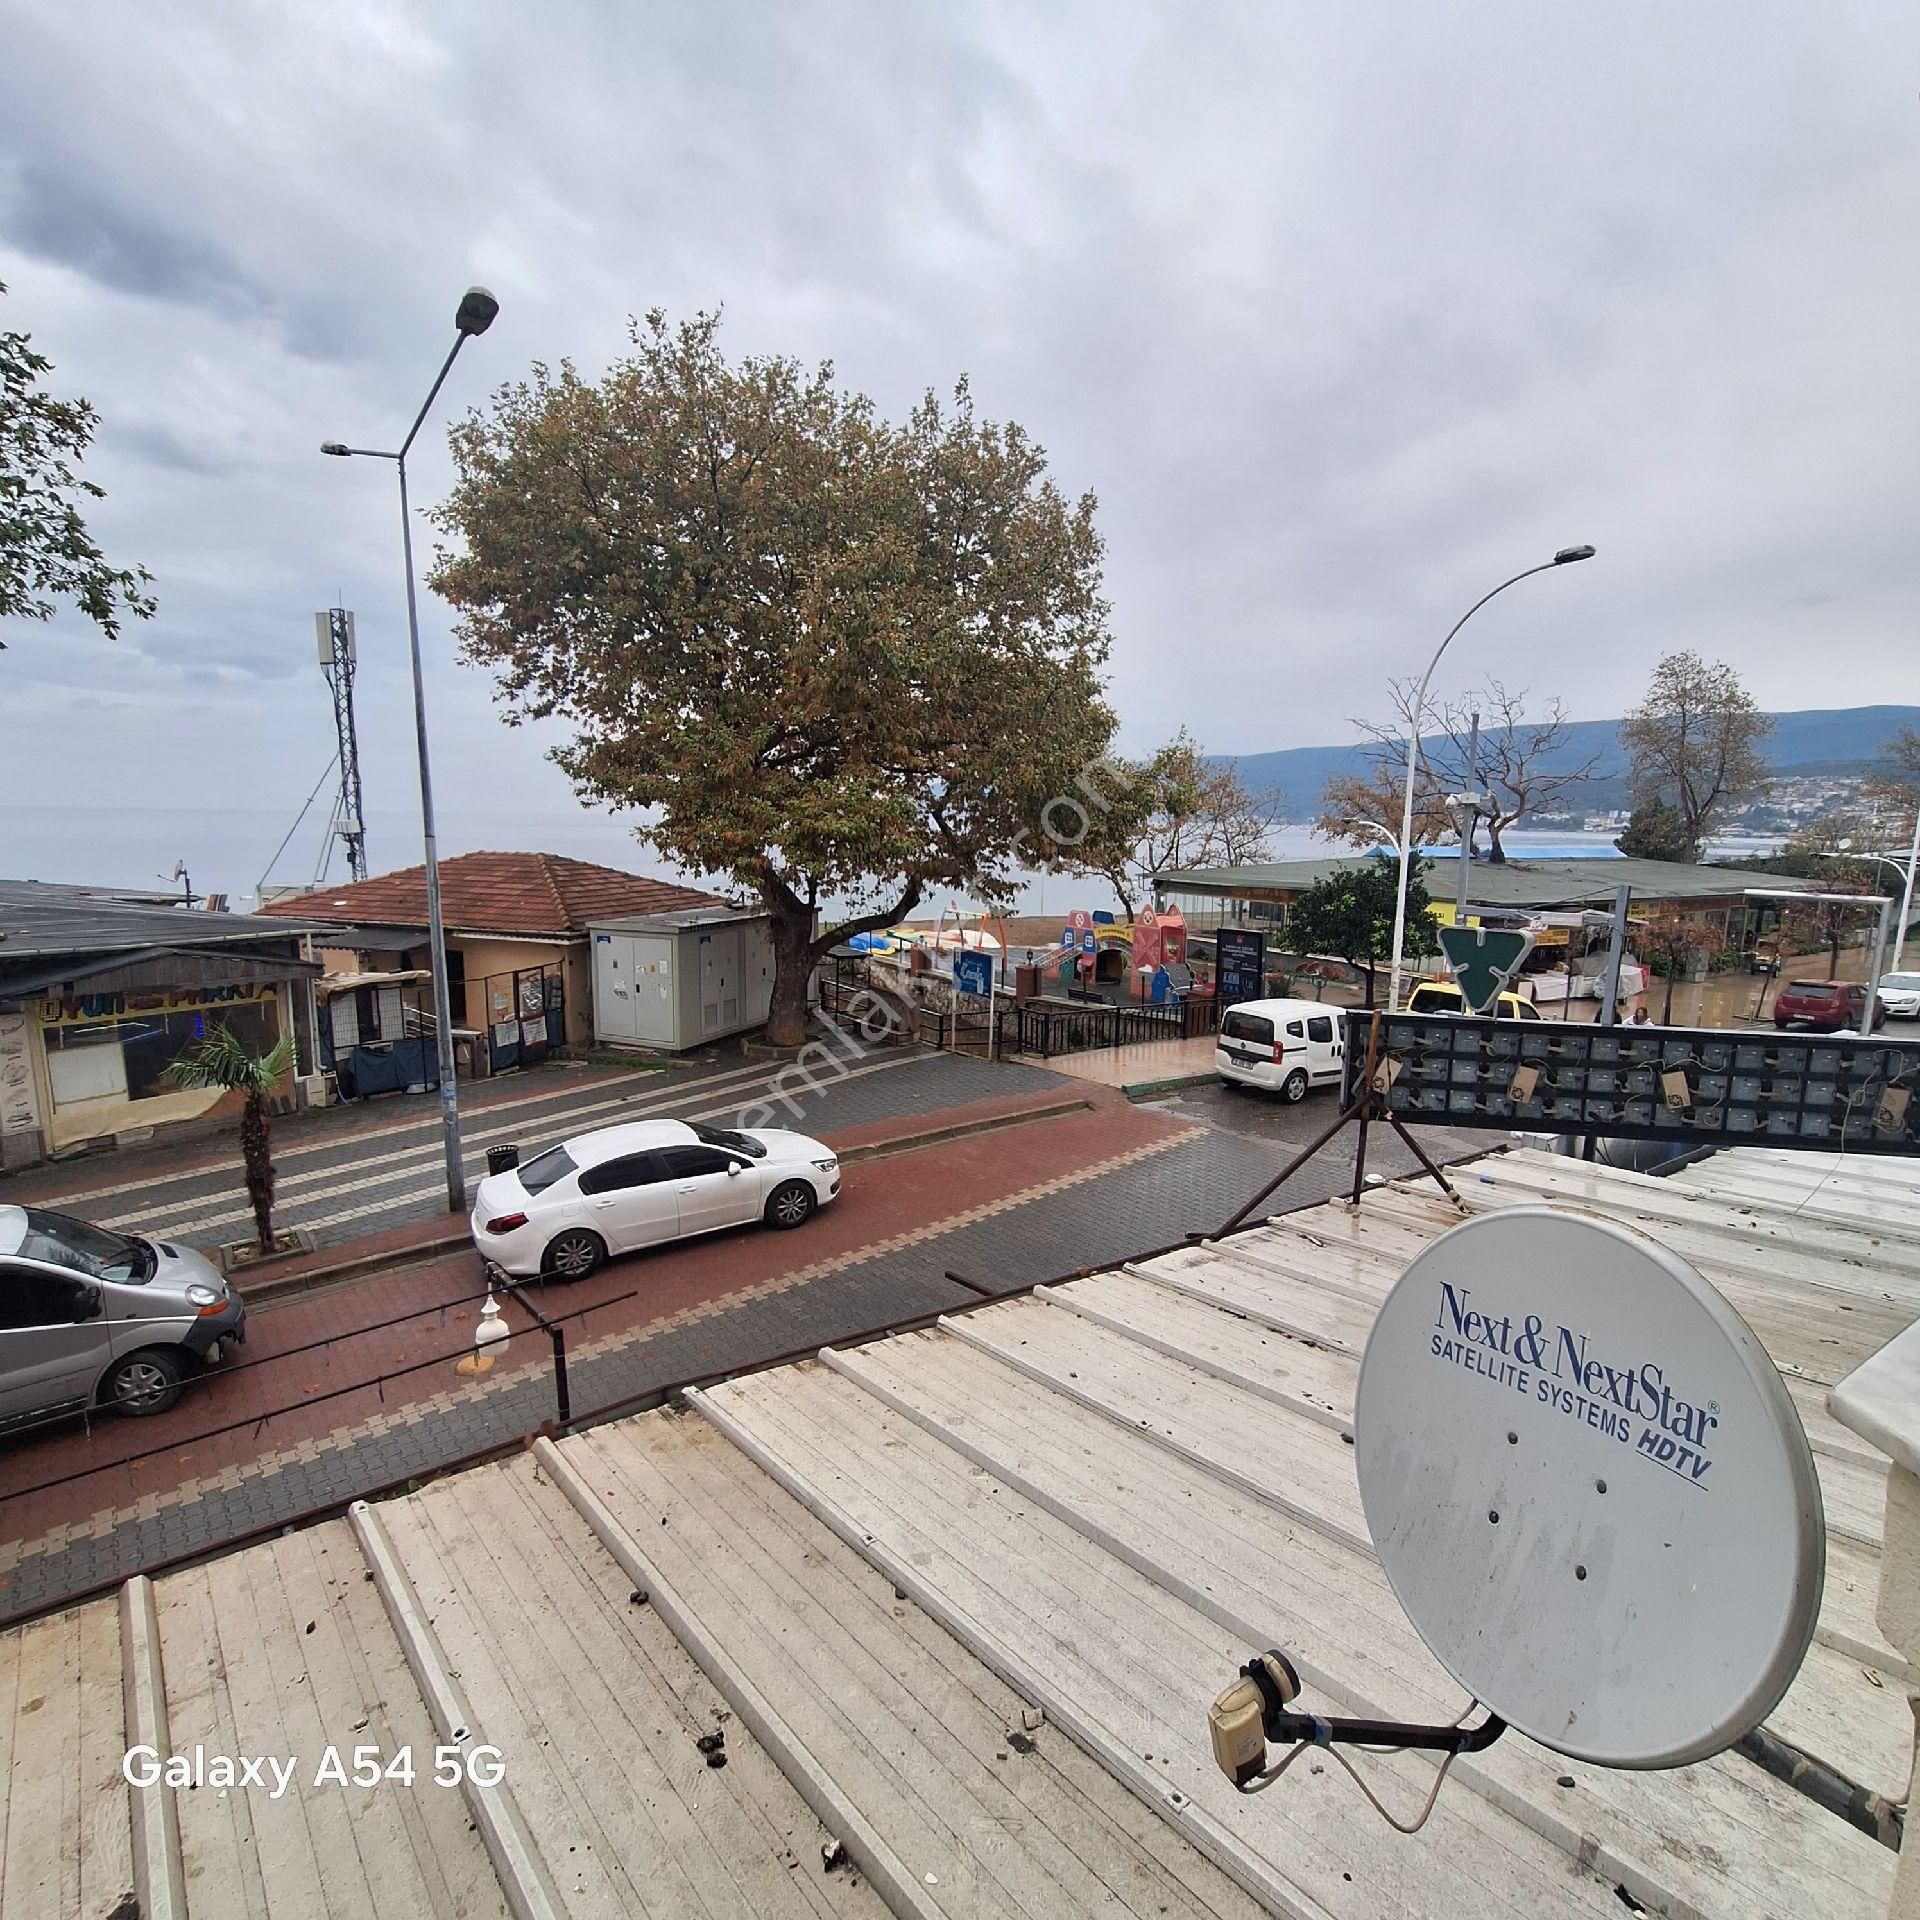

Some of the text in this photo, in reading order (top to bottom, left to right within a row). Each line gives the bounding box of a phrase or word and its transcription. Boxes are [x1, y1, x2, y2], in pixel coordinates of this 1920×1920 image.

[1431, 1334, 1713, 1480] SATELLITE SYSTEMS HDTV
